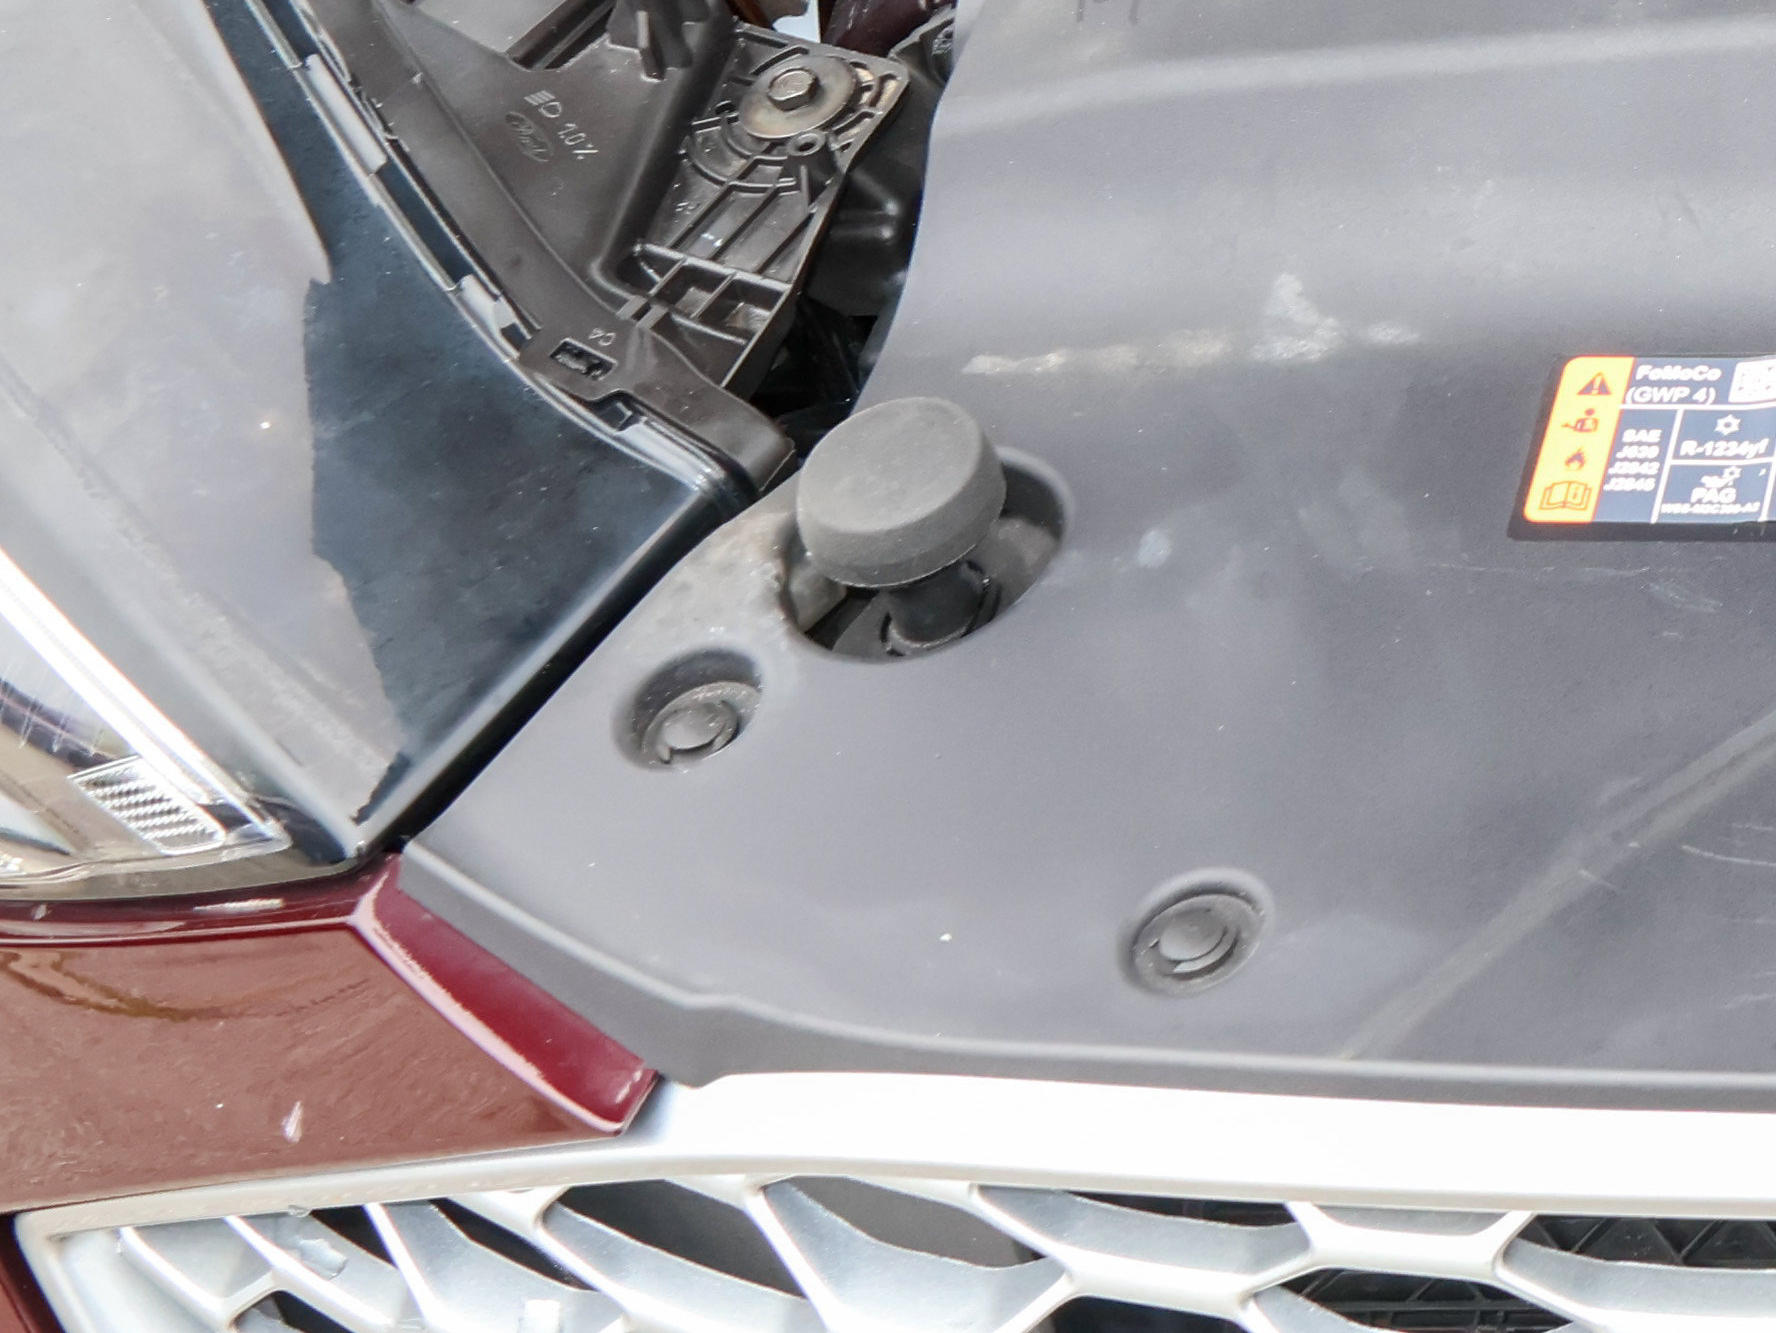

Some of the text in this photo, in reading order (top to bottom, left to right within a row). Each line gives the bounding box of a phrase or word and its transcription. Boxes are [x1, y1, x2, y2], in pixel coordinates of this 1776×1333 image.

[1635, 364, 1723, 382] FoMoCo
[1624, 385, 1717, 407] (GWP 4)
[1689, 486, 1738, 504] PAG
